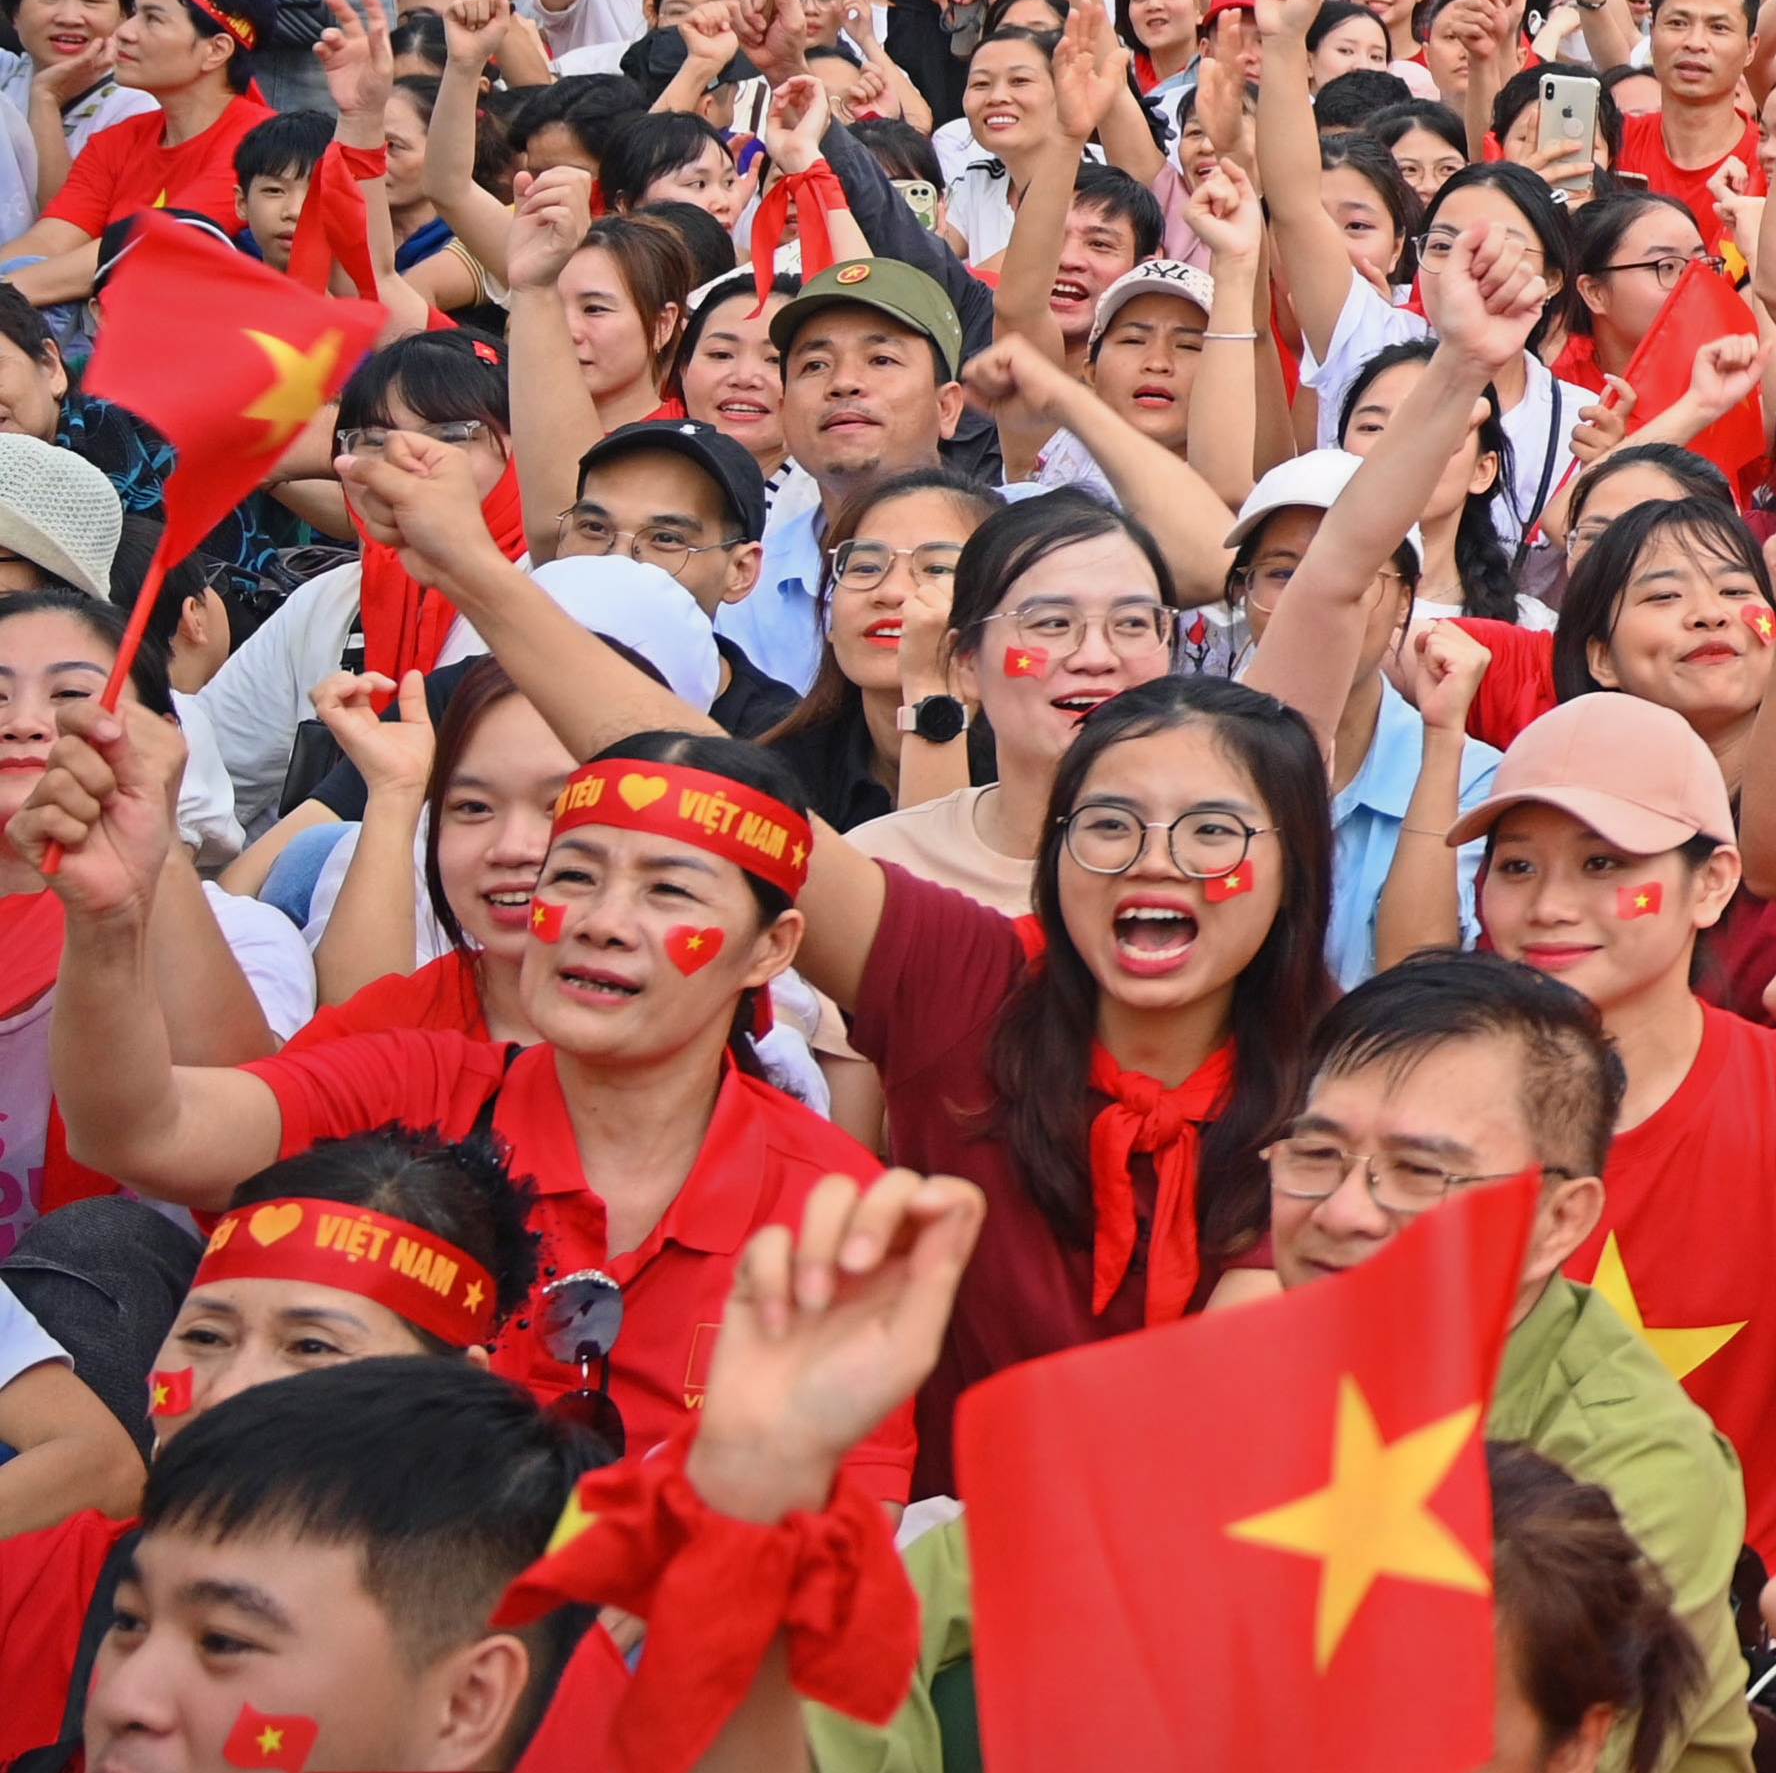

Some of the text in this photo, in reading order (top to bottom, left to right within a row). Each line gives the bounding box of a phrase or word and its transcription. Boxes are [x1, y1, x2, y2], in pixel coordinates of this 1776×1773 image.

[567, 774, 788, 860] YÊU VIỆT NAM
[314, 1214, 390, 1264] VIỆT
[388, 1243, 460, 1296] NAM
